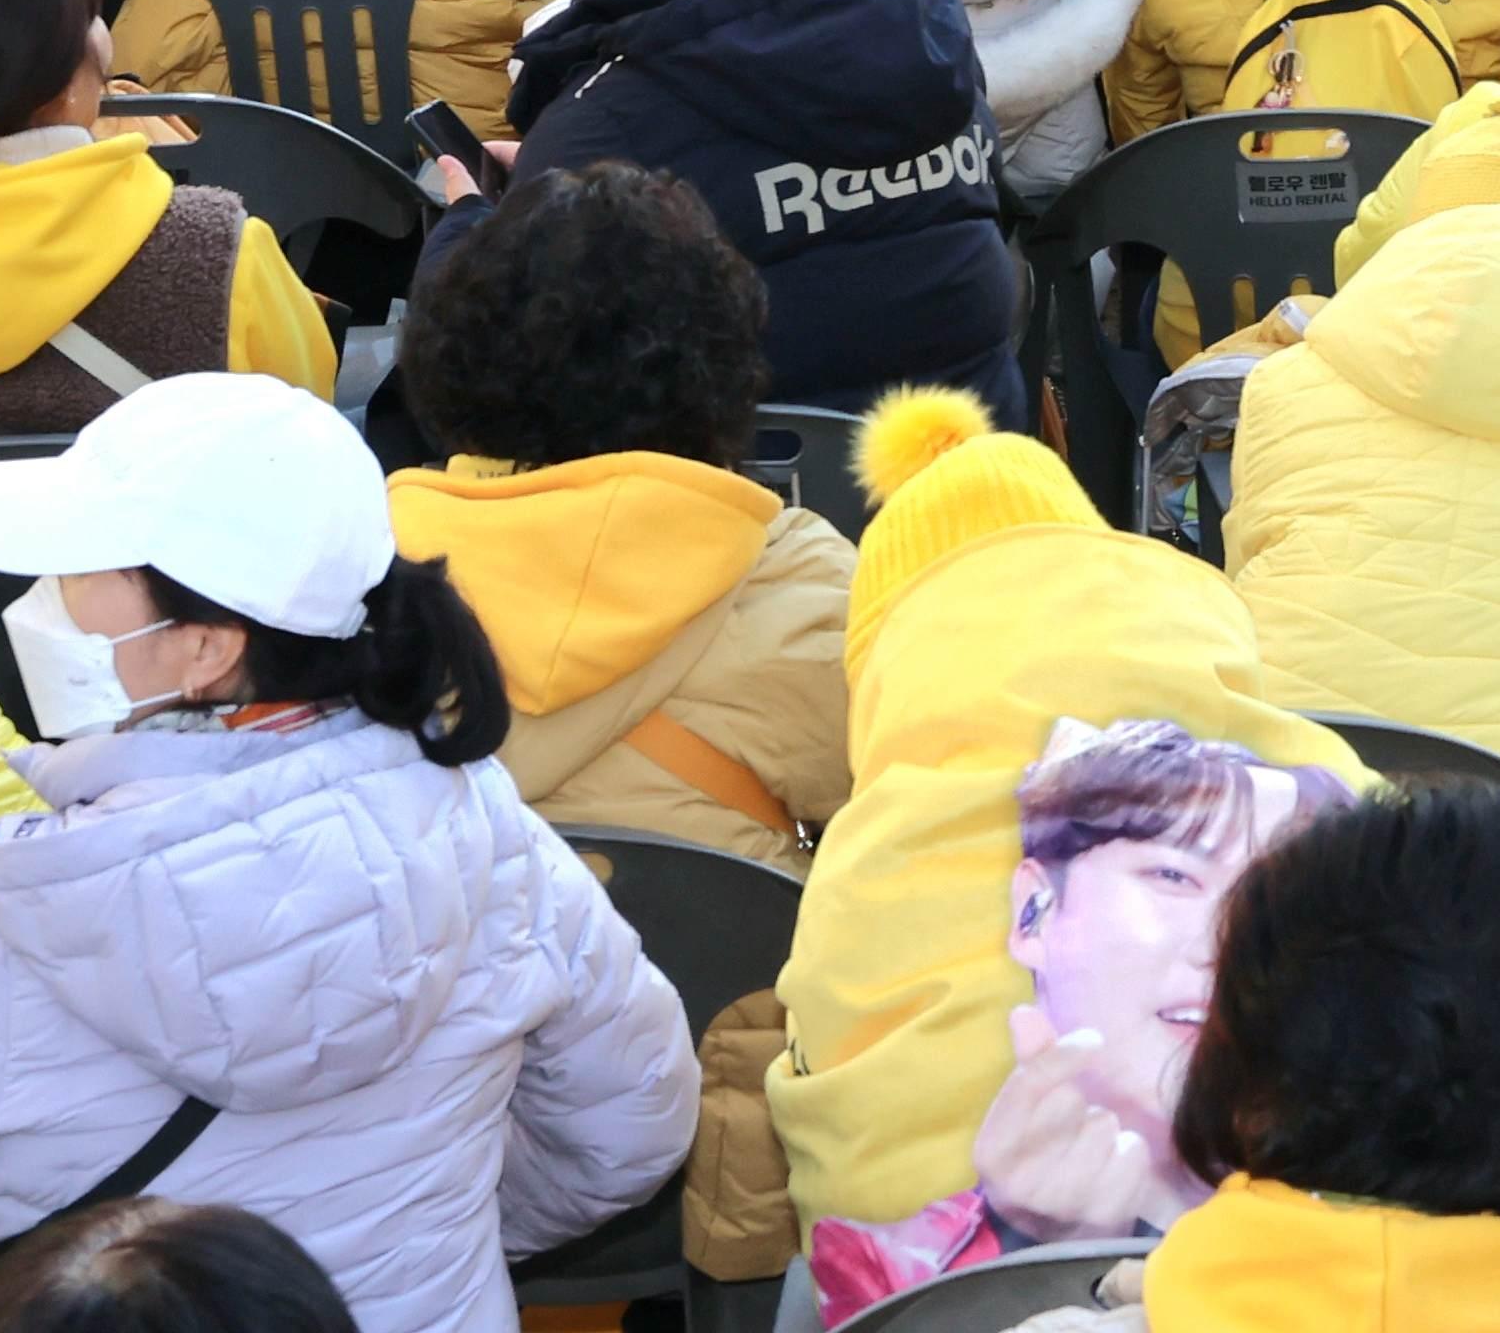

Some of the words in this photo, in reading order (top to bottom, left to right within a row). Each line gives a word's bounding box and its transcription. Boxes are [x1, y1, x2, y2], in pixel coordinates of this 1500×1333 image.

[1248, 176, 1304, 192] 헬로우
[1309, 173, 1347, 190] 렌탈
[1249, 194, 1292, 208] HELLO
[1295, 192, 1347, 207] RENTAL
